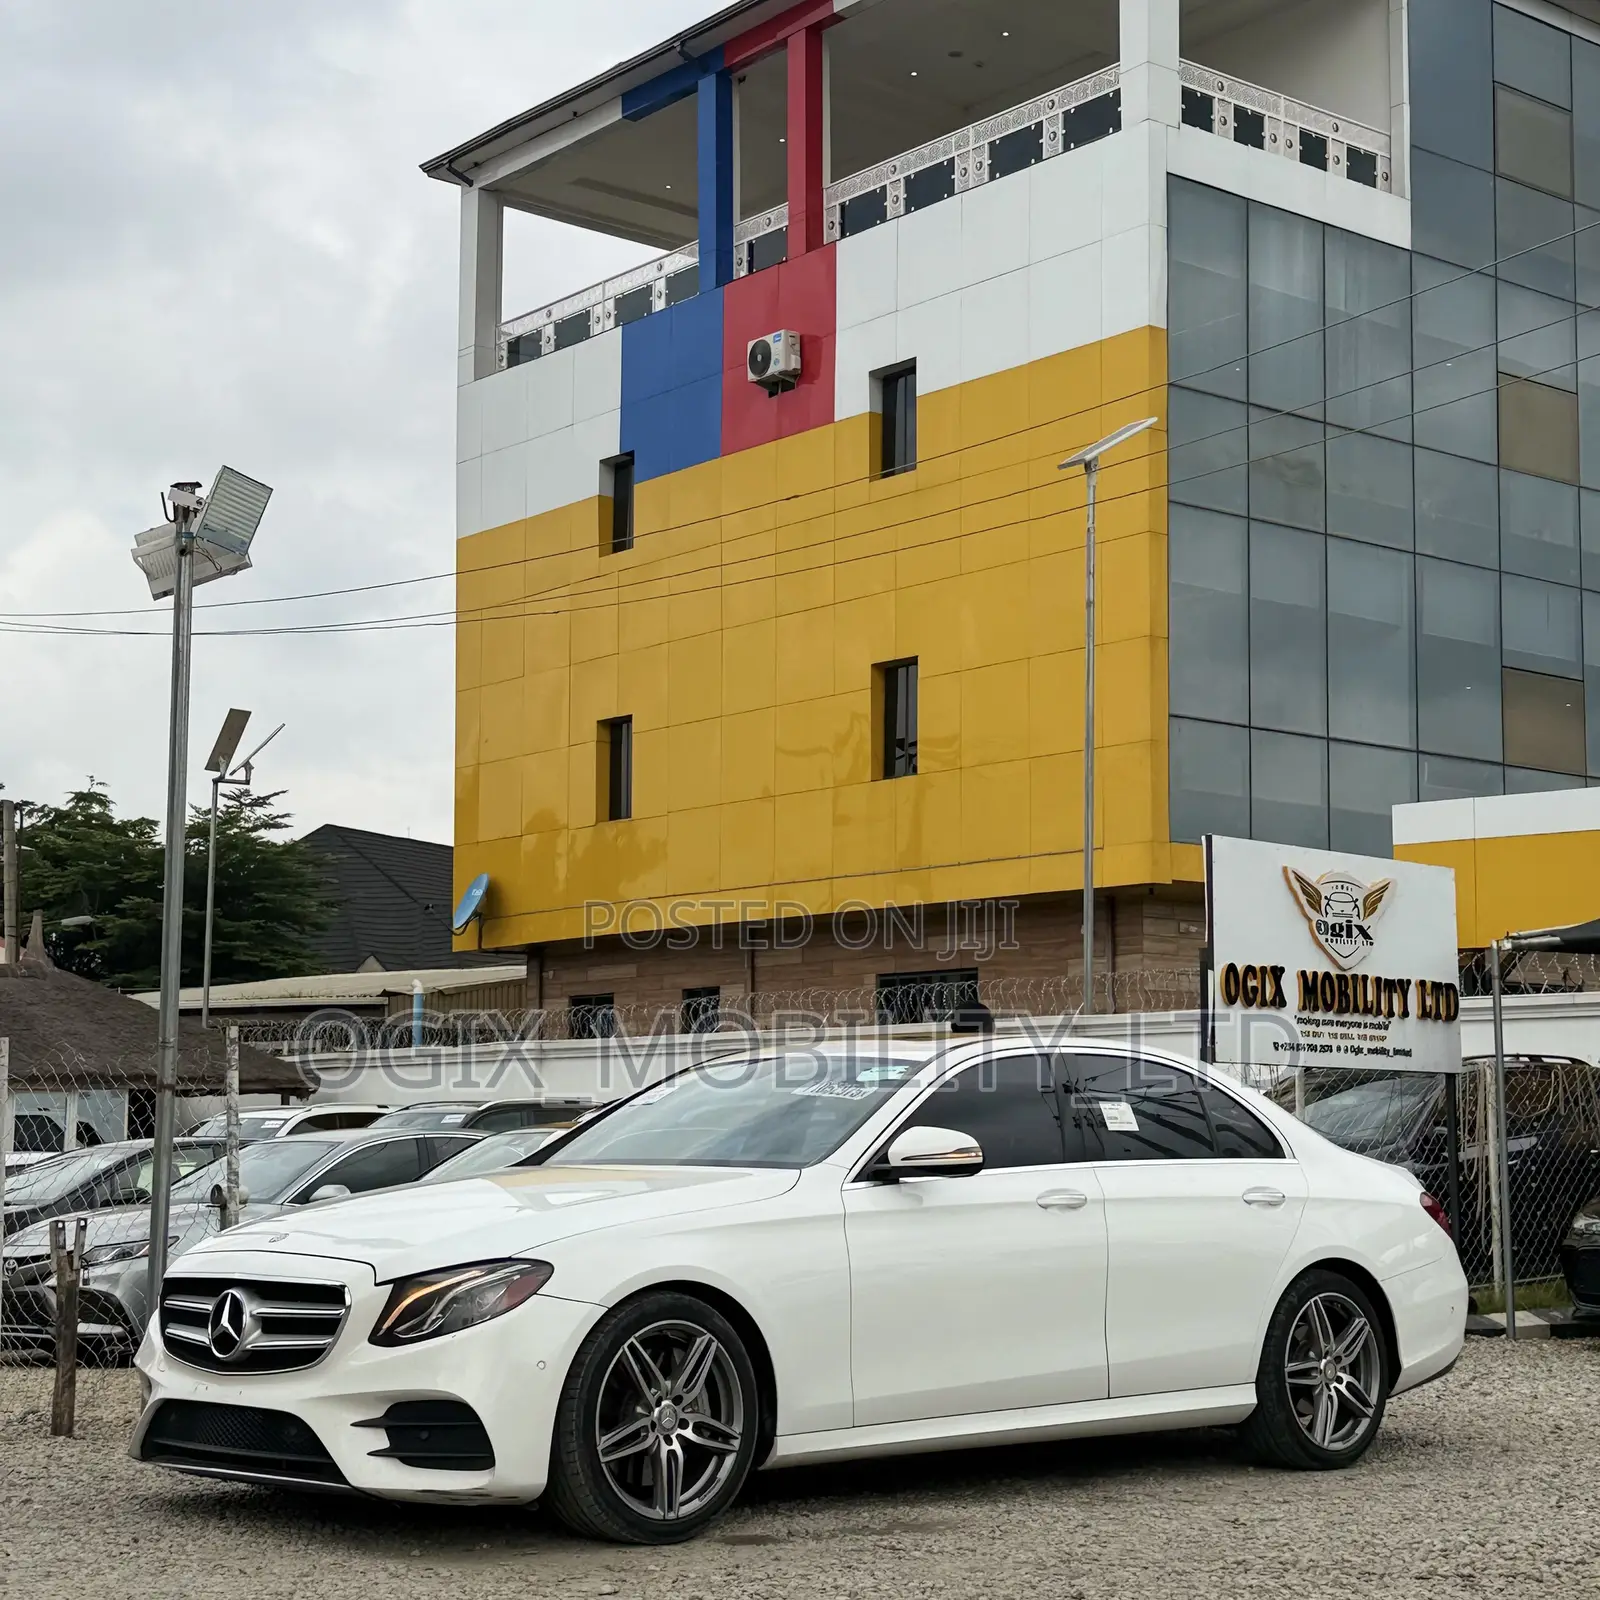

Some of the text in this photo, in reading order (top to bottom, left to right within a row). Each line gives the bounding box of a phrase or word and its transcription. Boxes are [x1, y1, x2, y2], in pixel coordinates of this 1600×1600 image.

[1220, 962, 1460, 1022] OGIX MOBILITY LTD
